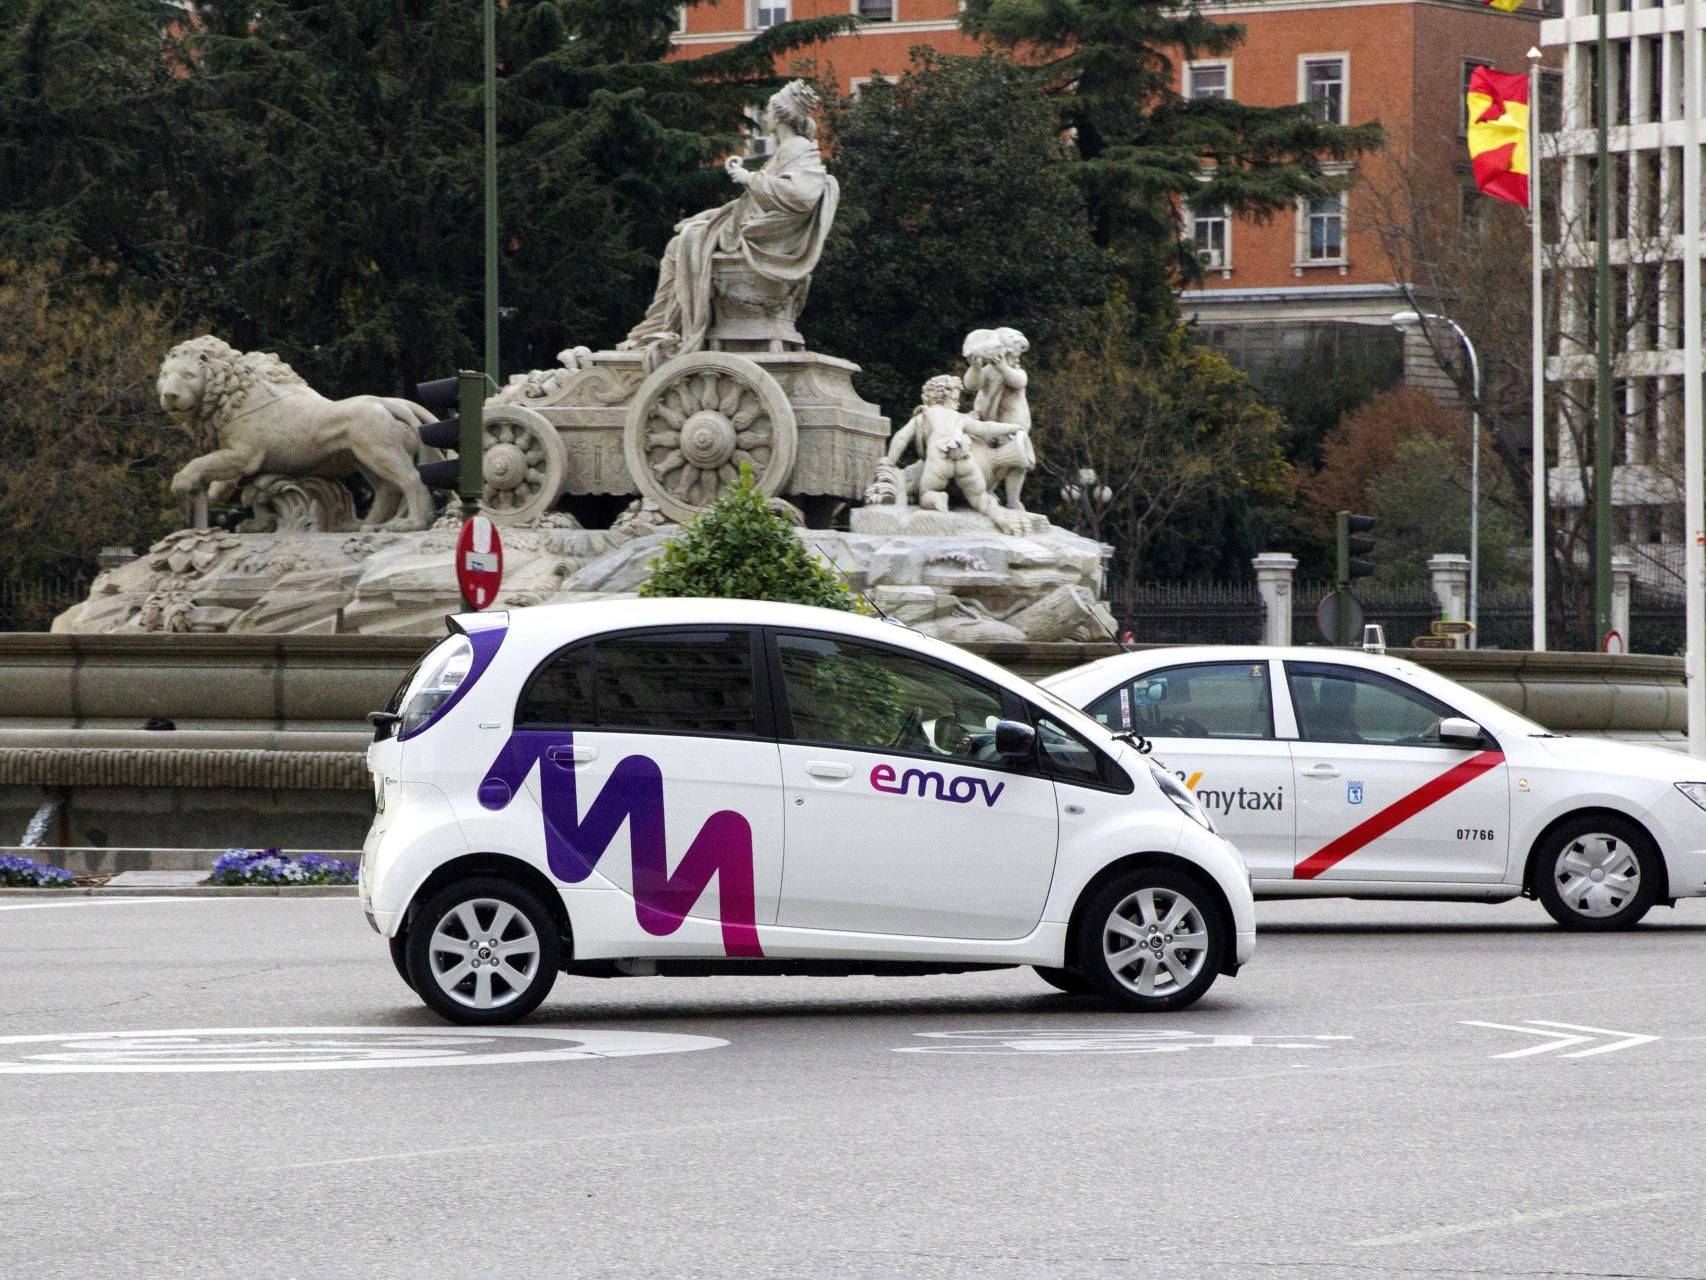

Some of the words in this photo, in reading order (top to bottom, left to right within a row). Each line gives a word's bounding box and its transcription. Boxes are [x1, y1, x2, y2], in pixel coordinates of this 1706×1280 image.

[870, 764, 1005, 807] emov
[1197, 786, 1283, 816] mytaxi
[1456, 829, 1494, 840] 07766
